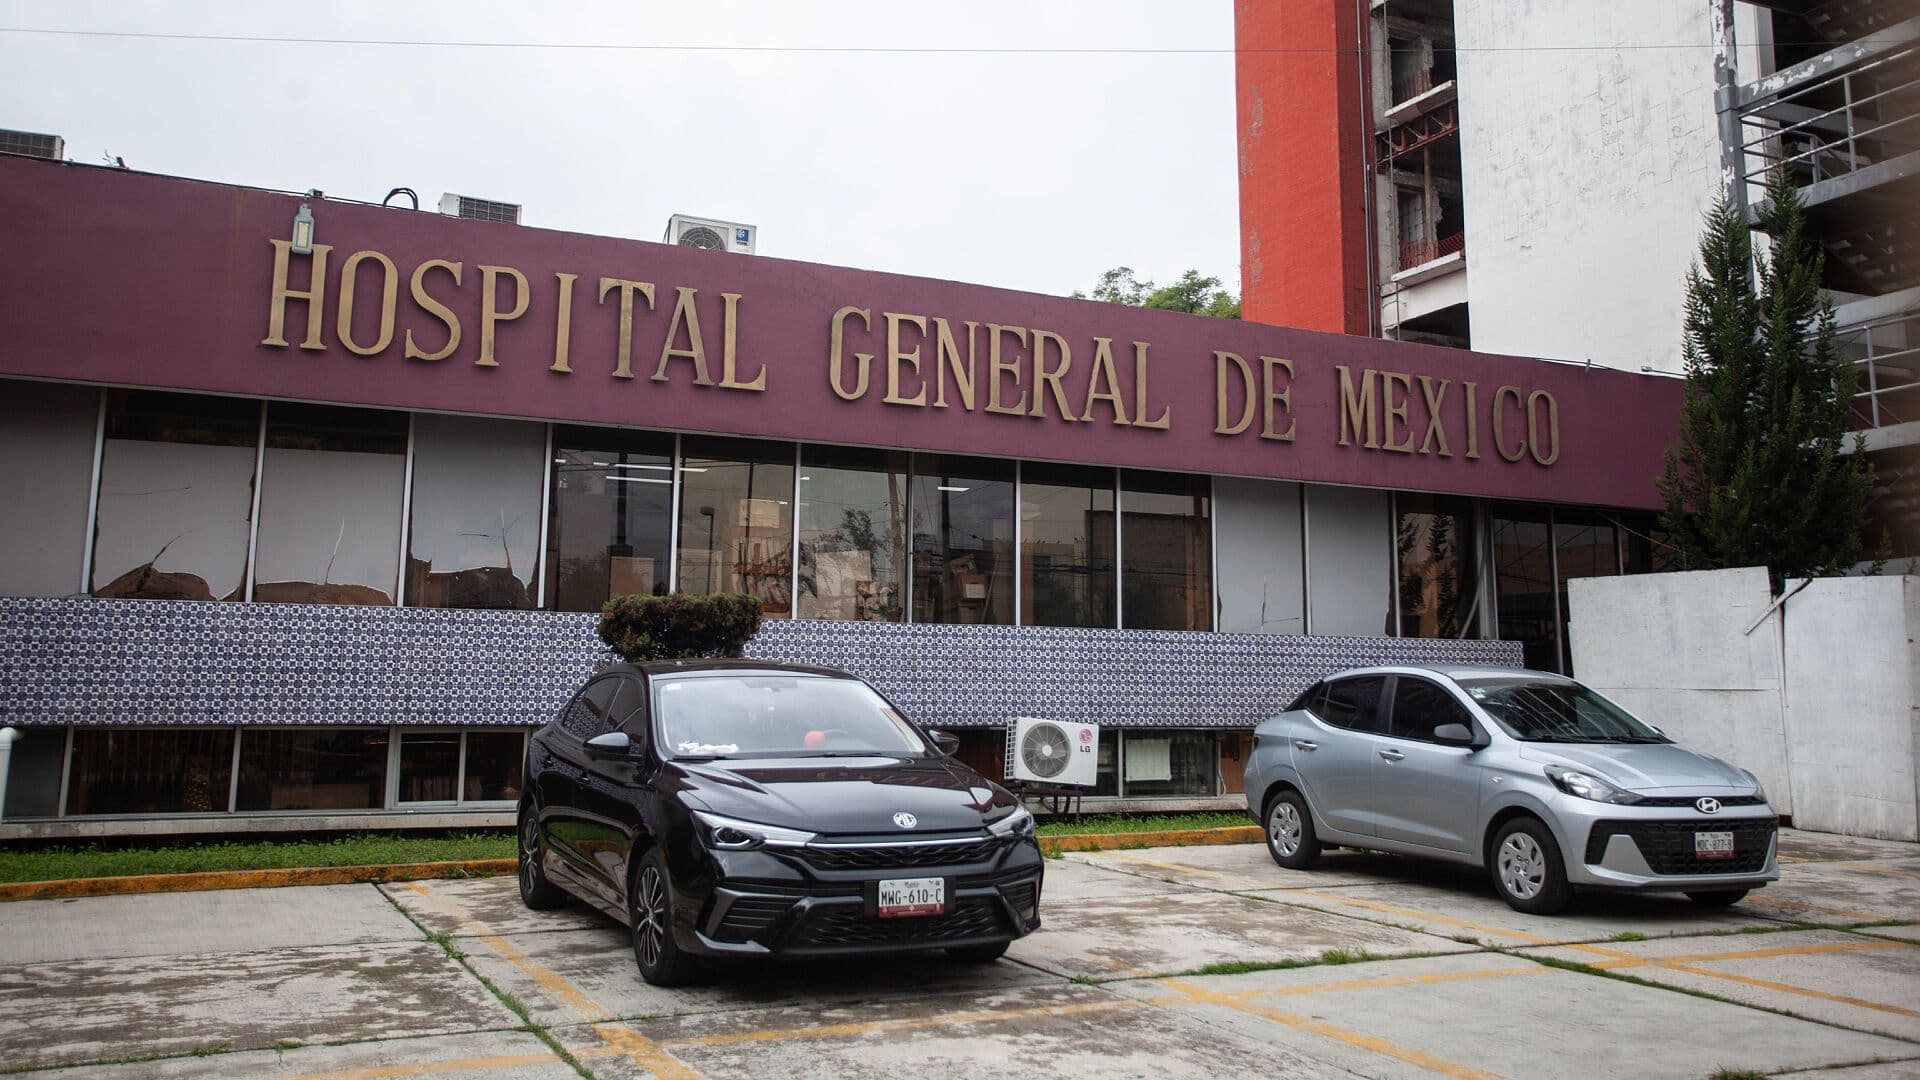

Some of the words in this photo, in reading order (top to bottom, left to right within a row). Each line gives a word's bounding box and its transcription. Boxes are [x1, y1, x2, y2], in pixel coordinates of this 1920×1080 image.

[262, 239, 767, 391] HOSPITAL
[829, 306, 1171, 430] GENERAL
[1213, 350, 1296, 442] DE
[1336, 365, 1561, 466] MEXICO
[1080, 744, 1091, 753] LG
[881, 889, 942, 905] MWG-610-C
